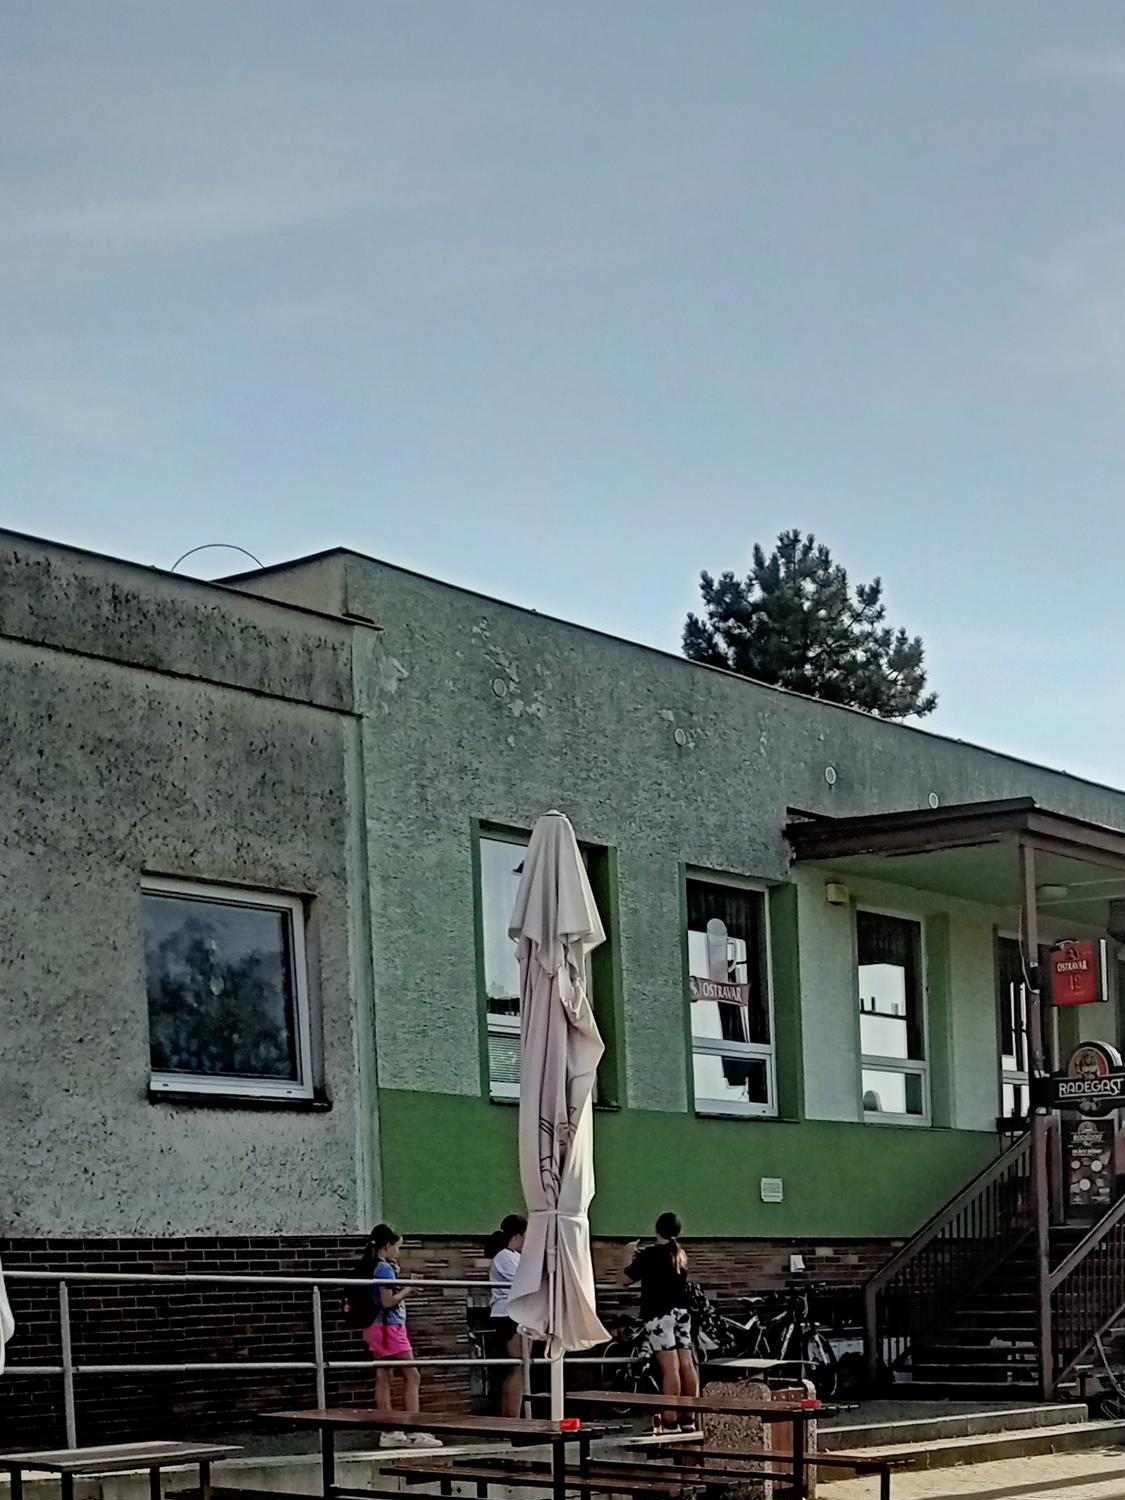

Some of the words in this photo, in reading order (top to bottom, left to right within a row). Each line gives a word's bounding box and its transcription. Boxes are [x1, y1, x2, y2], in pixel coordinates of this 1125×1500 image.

[1056, 960, 1088, 973] OSTRAVAR
[702, 982, 742, 1001] OSTRAVAR
[1058, 1077, 1125, 1097] RADEGAST
